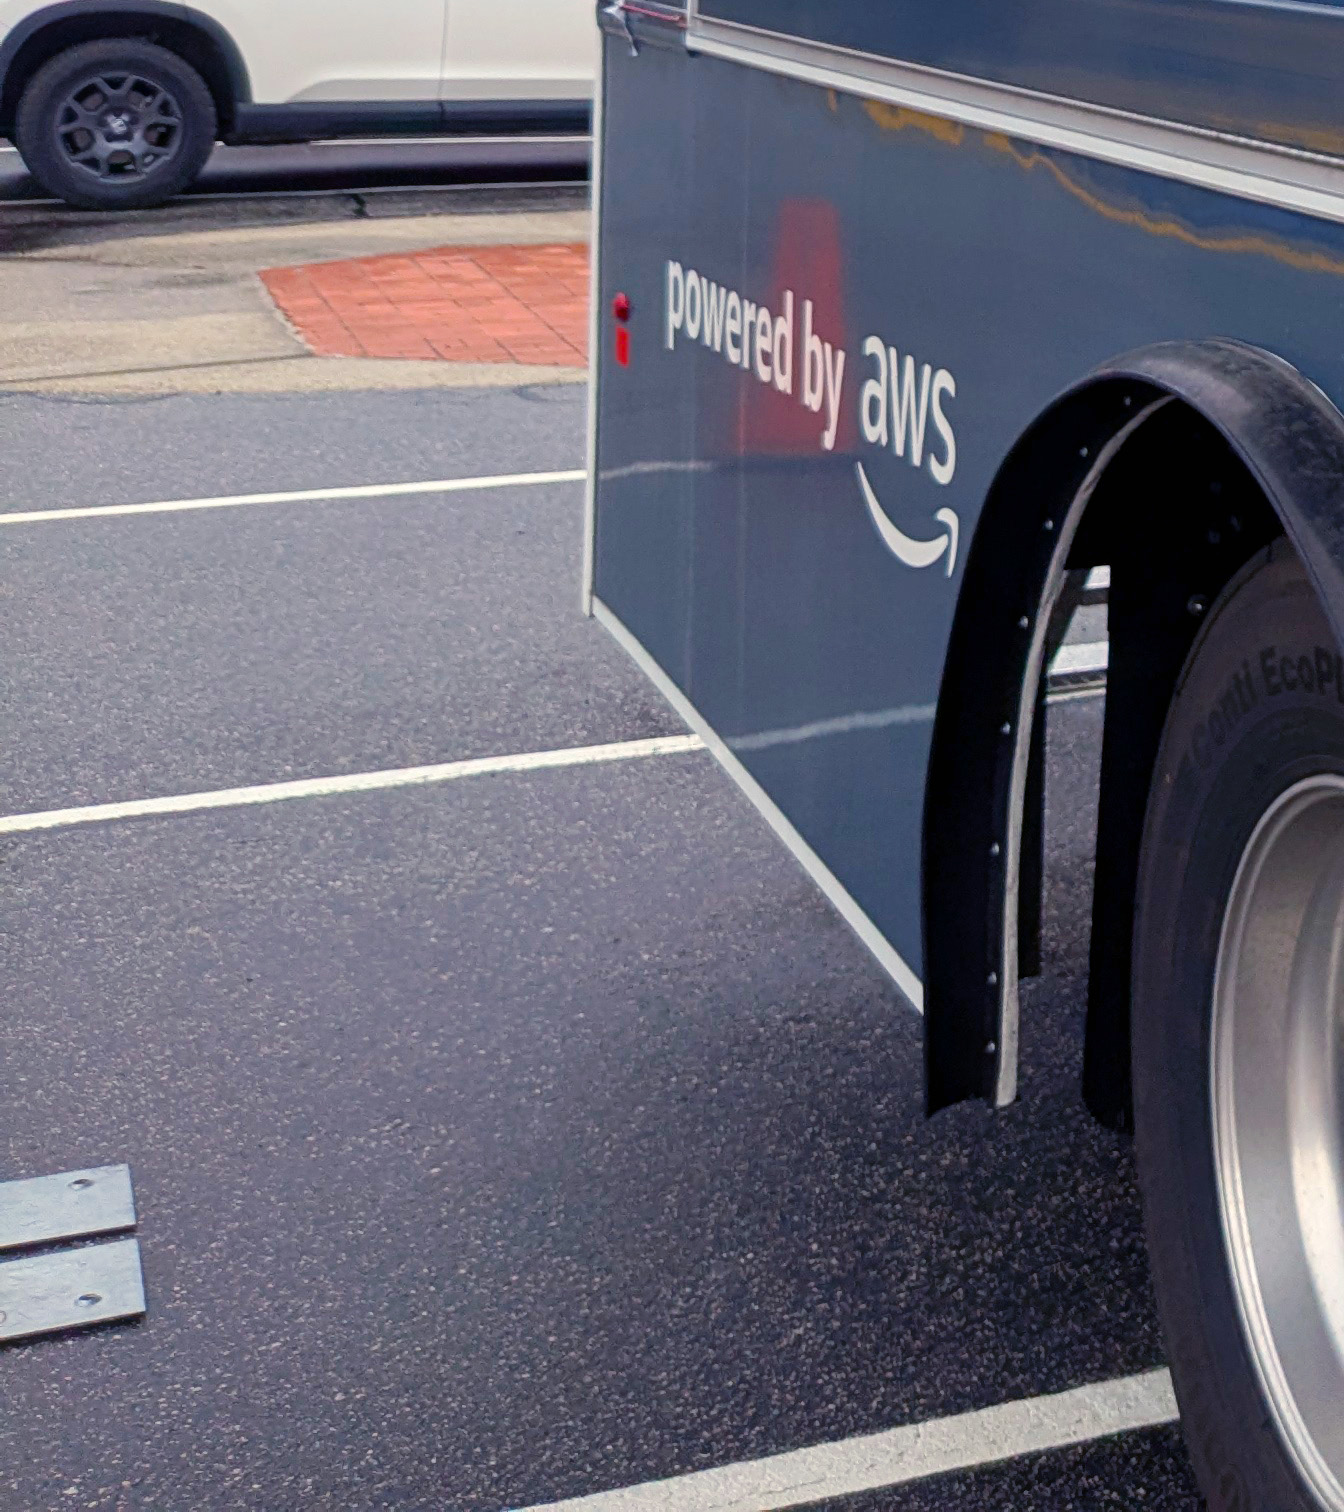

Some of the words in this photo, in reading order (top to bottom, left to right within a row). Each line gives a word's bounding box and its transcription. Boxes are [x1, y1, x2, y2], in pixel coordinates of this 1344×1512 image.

[665, 259, 795, 396] powered
[802, 299, 847, 451] by
[859, 334, 957, 486] aws
